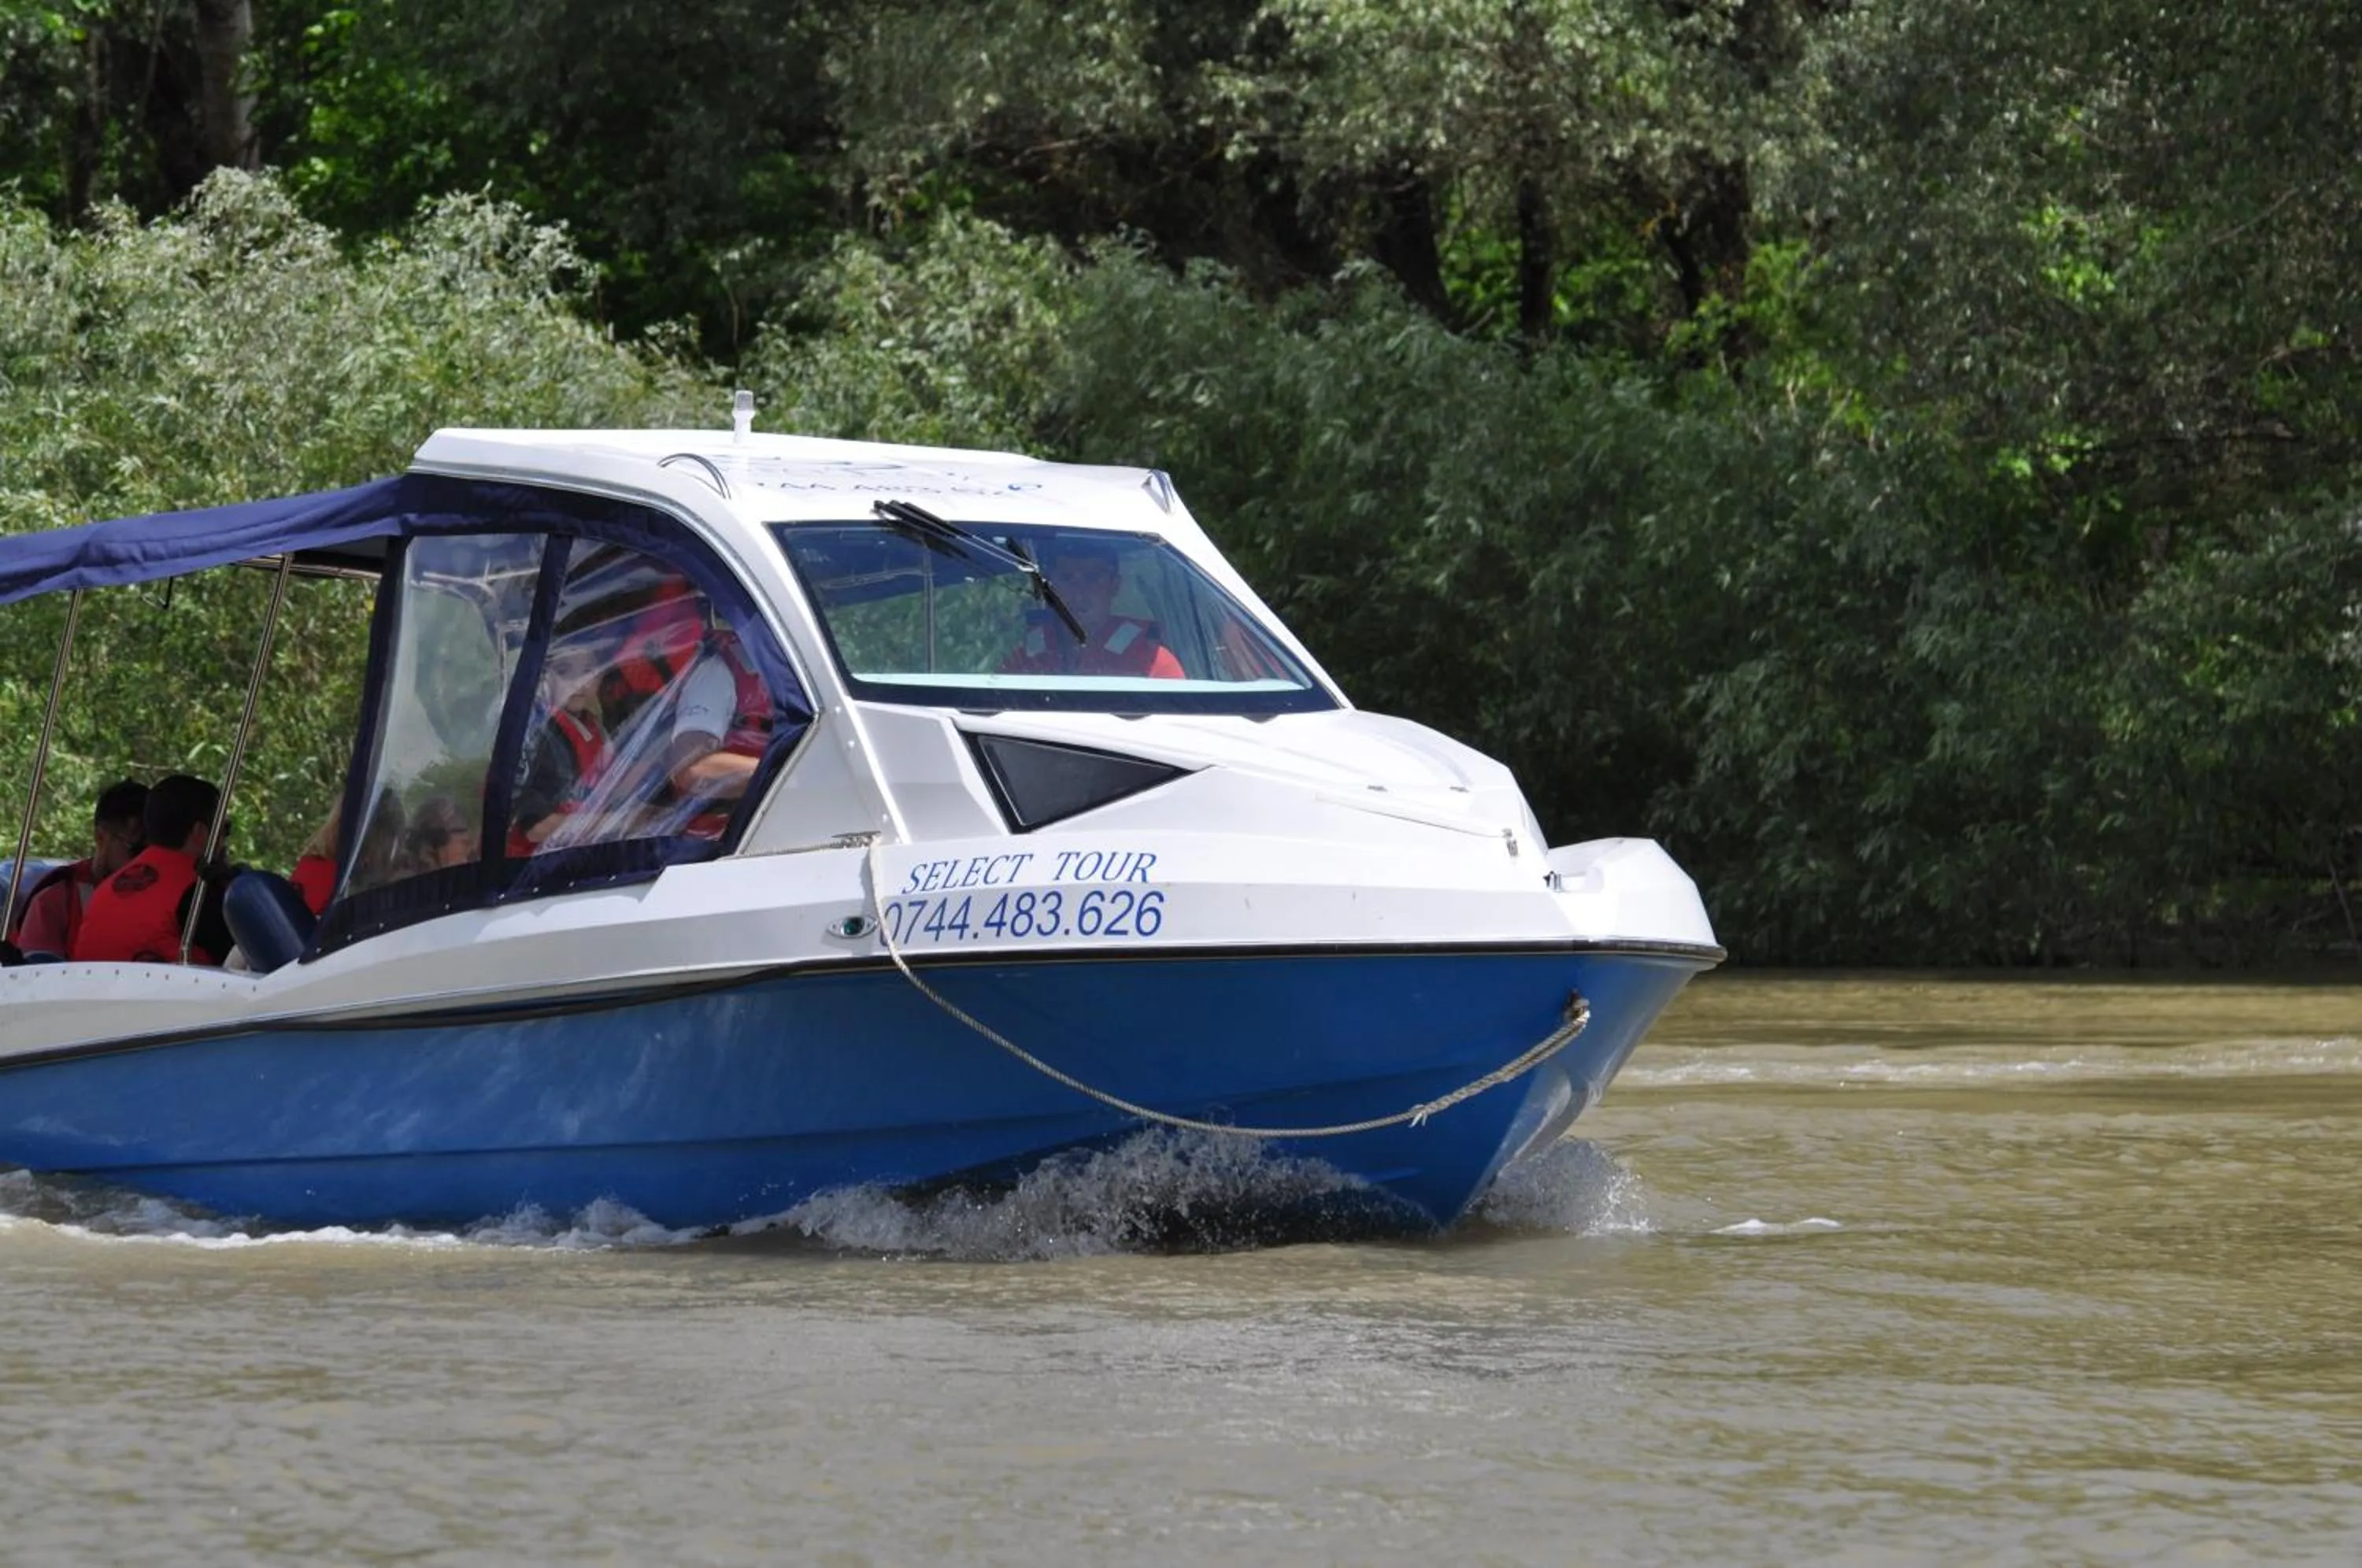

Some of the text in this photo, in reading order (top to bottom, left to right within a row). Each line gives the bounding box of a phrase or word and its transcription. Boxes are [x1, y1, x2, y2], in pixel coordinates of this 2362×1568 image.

[903, 851, 1157, 894] SELECT TOUR
[880, 890, 1164, 946] 0744.483.626
